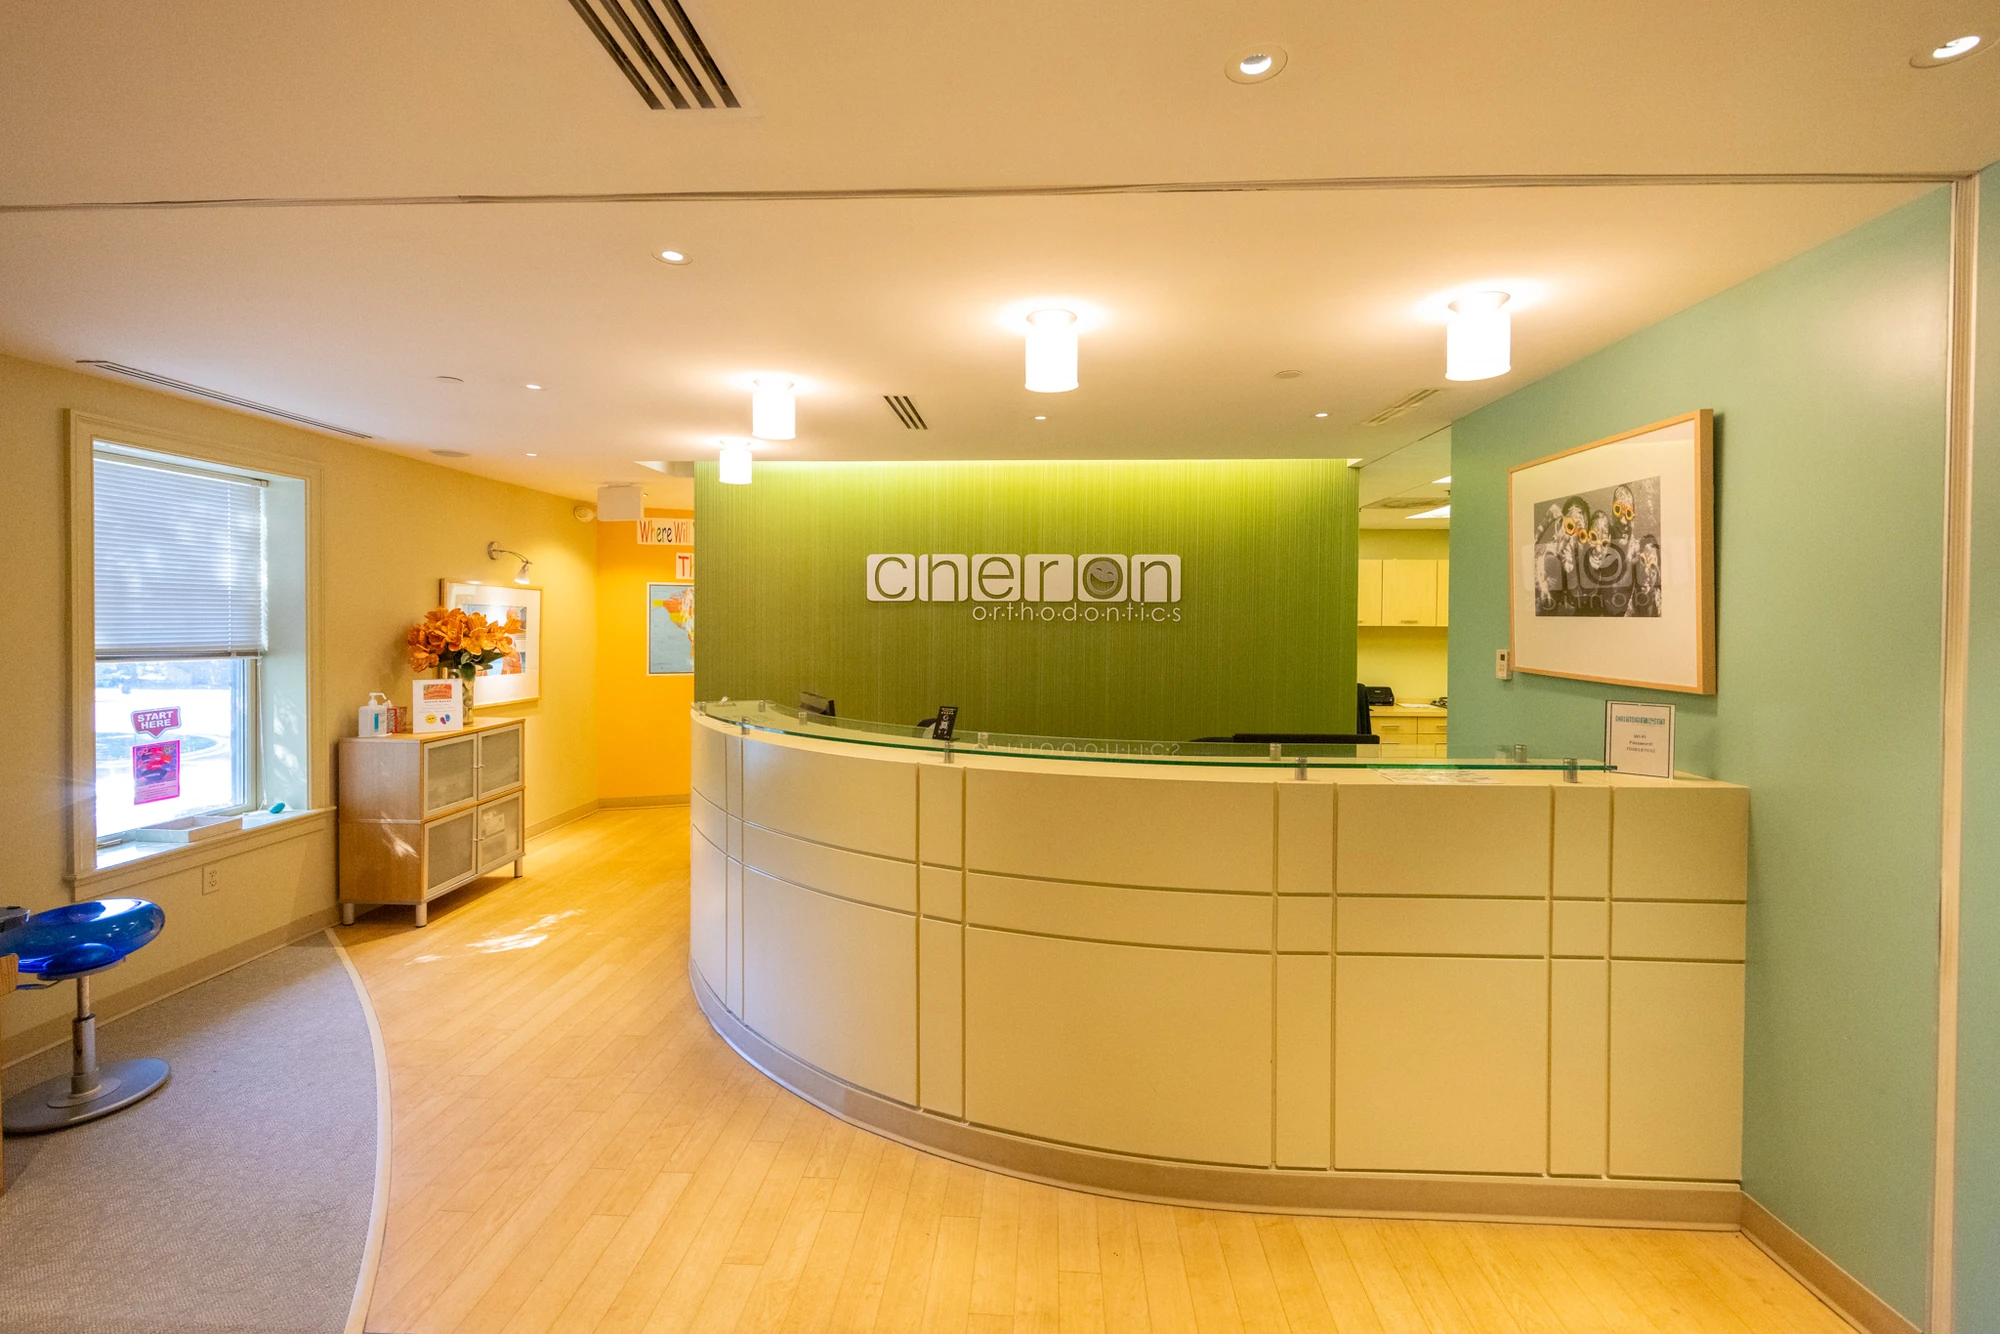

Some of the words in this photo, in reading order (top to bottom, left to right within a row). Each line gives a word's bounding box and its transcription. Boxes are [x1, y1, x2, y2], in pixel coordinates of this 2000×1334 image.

[640, 520, 672, 543] Where
[867, 554, 1181, 602] cheron
[137, 711, 174, 722] START
[141, 719, 171, 729] HERE
